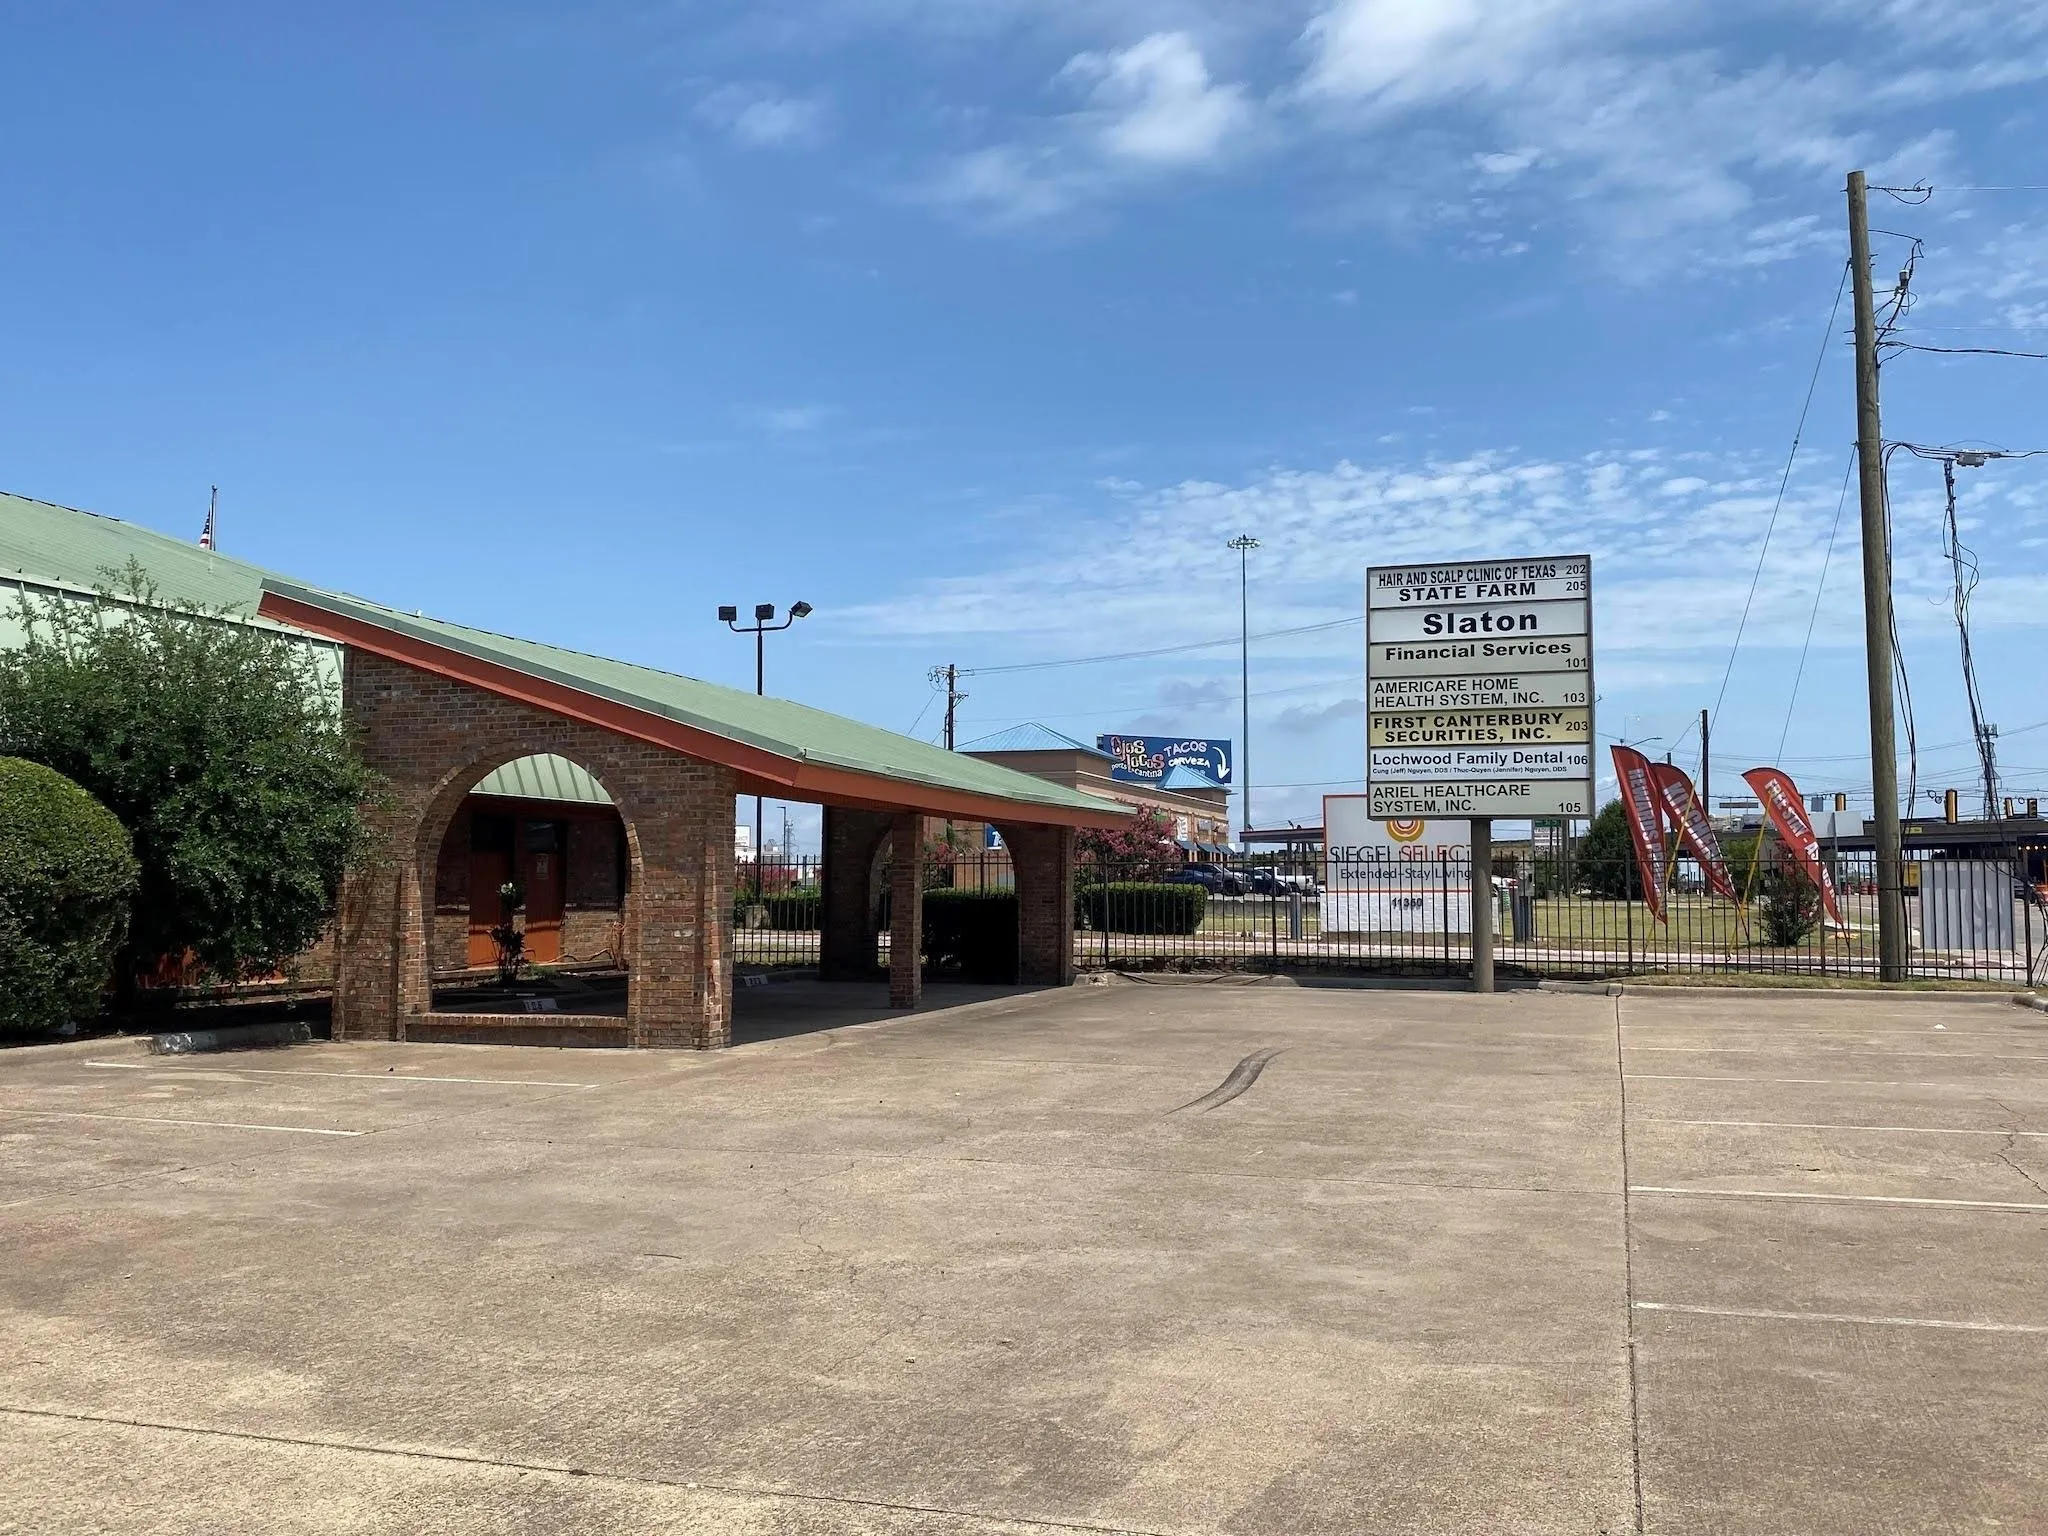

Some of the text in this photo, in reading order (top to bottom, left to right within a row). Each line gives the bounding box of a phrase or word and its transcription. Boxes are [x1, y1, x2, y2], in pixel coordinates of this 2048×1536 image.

[1379, 564, 1557, 587] HAIR AND SCALP CLINIC OF TEXAS
[1565, 564, 1587, 576] 202
[1399, 582, 1536, 602] STATE FARM
[1565, 580, 1587, 592] 205
[1423, 610, 1538, 635] Slaton
[1385, 641, 1572, 661] Financial Services
[1565, 657, 1587, 668] 101
[1374, 677, 1519, 694] AMERICARE HOME
[1374, 691, 1544, 708] HEALTH SYSTEM, INC.
[1563, 692, 1585, 703] 103
[1374, 712, 1563, 730] FIRST CANTERBURY
[1565, 721, 1588, 732] 203
[1385, 727, 1551, 743] SECURITIES, INC.
[1163, 741, 1207, 757] TACOS
[1373, 750, 1563, 767] Lochwood Family Dental
[1566, 755, 1588, 765] 106
[1374, 784, 1530, 799] ARIEL HEALTHCARE
[1374, 799, 1476, 813] SYSTEM, INC.
[1558, 802, 1581, 813] 105
[1628, 768, 1660, 842] REWARDS
[1765, 778, 1789, 810] FREE
[1782, 806, 1809, 838] STAY
[1435, 867, 1472, 881] Lving
